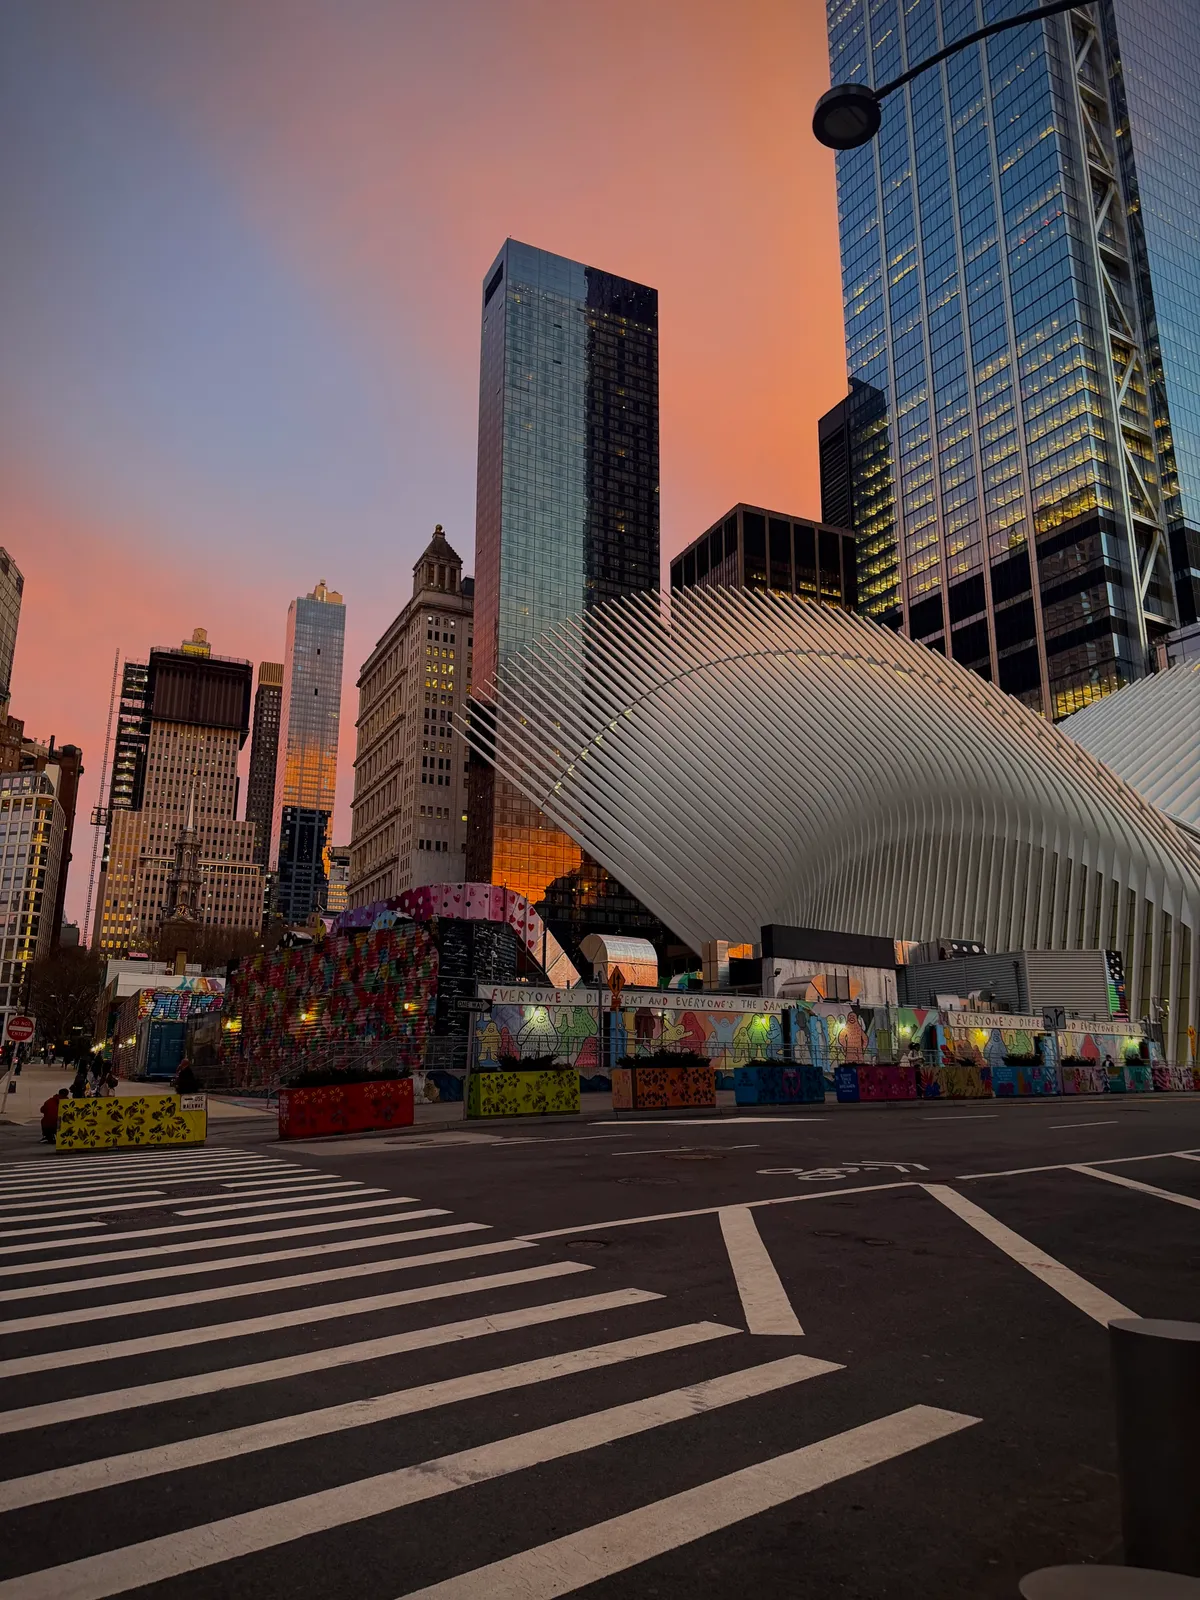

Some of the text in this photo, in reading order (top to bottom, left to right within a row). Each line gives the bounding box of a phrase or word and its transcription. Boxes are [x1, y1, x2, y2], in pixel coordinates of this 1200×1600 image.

[457, 1001, 484, 1010] ONE WAY
[491, 988, 576, 1003] EVERYONE'S
[586, 993, 644, 1005] DIFENT
[648, 994, 668, 1006] AND
[676, 996, 734, 1009] EVERYONE'S
[741, 998, 757, 1009] THE
[957, 1014, 1012, 1027] EVERYONE'S
[1081, 1021, 1120, 1033] EVERYONE'S
